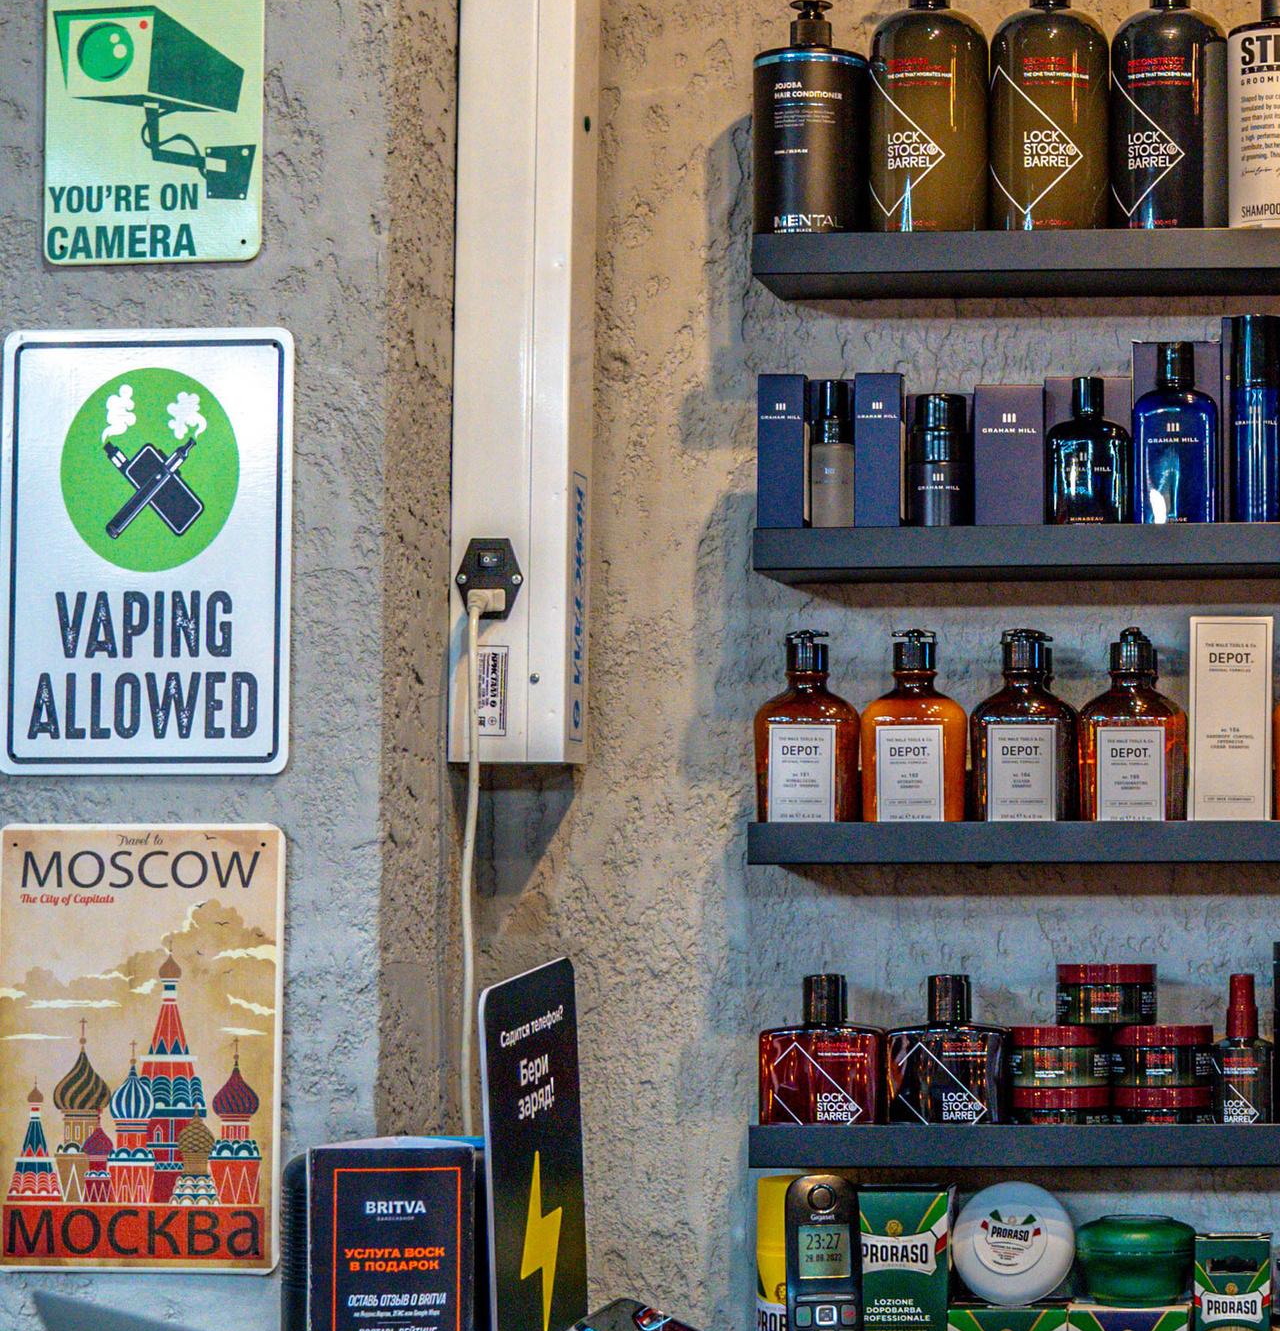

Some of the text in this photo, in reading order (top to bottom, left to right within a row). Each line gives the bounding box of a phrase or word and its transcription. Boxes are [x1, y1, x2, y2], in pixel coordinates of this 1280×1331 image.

[775, 82, 802, 90] JOJOBA
[792, 91, 843, 100] CONDITIONER
[888, 132, 921, 145] LOCK
[1024, 131, 1060, 143] LOCK
[1128, 132, 1160, 145] LOCK
[888, 156, 932, 170] BARREL
[1024, 156, 1071, 168] BARREL
[1128, 157, 1172, 170] BARREL
[49, 183, 198, 213] YOU'RE ON
[774, 215, 843, 228] MENTAL
[48, 224, 196, 260] CAMERA
[55, 590, 233, 659] VAPING
[28, 671, 258, 740] ALLOWED
[116, 833, 164, 846] Travel to
[21, 851, 260, 889] MOSCOW
[20, 894, 114, 905] The City of Capitals
[501, 1005, 563, 1048] Садится телефон?
[520, 1054, 549, 1086] Бери
[519, 1077, 555, 1119] заряд!
[816, 1093, 845, 1102] LOCK
[942, 1092, 971, 1102] LOCK
[816, 1111, 853, 1121] BARREL
[942, 1110, 979, 1121] BARREL
[365, 1201, 426, 1214] BRITVA
[990, 1226, 1029, 1242] PRORASO
[806, 1233, 841, 1250] 23:27
[345, 1247, 445, 1258] УСЛУГА ВОСК
[805, 1254, 842, 1263] 28.08.2022
[350, 1260, 439, 1272] В ПОДАРОК
[348, 1295, 378, 1307] ОСТАВЬ
[380, 1294, 409, 1306] ОТЗЫВ
[418, 1293, 447, 1305] BRITVA
[1207, 1300, 1257, 1316] PRORASO
